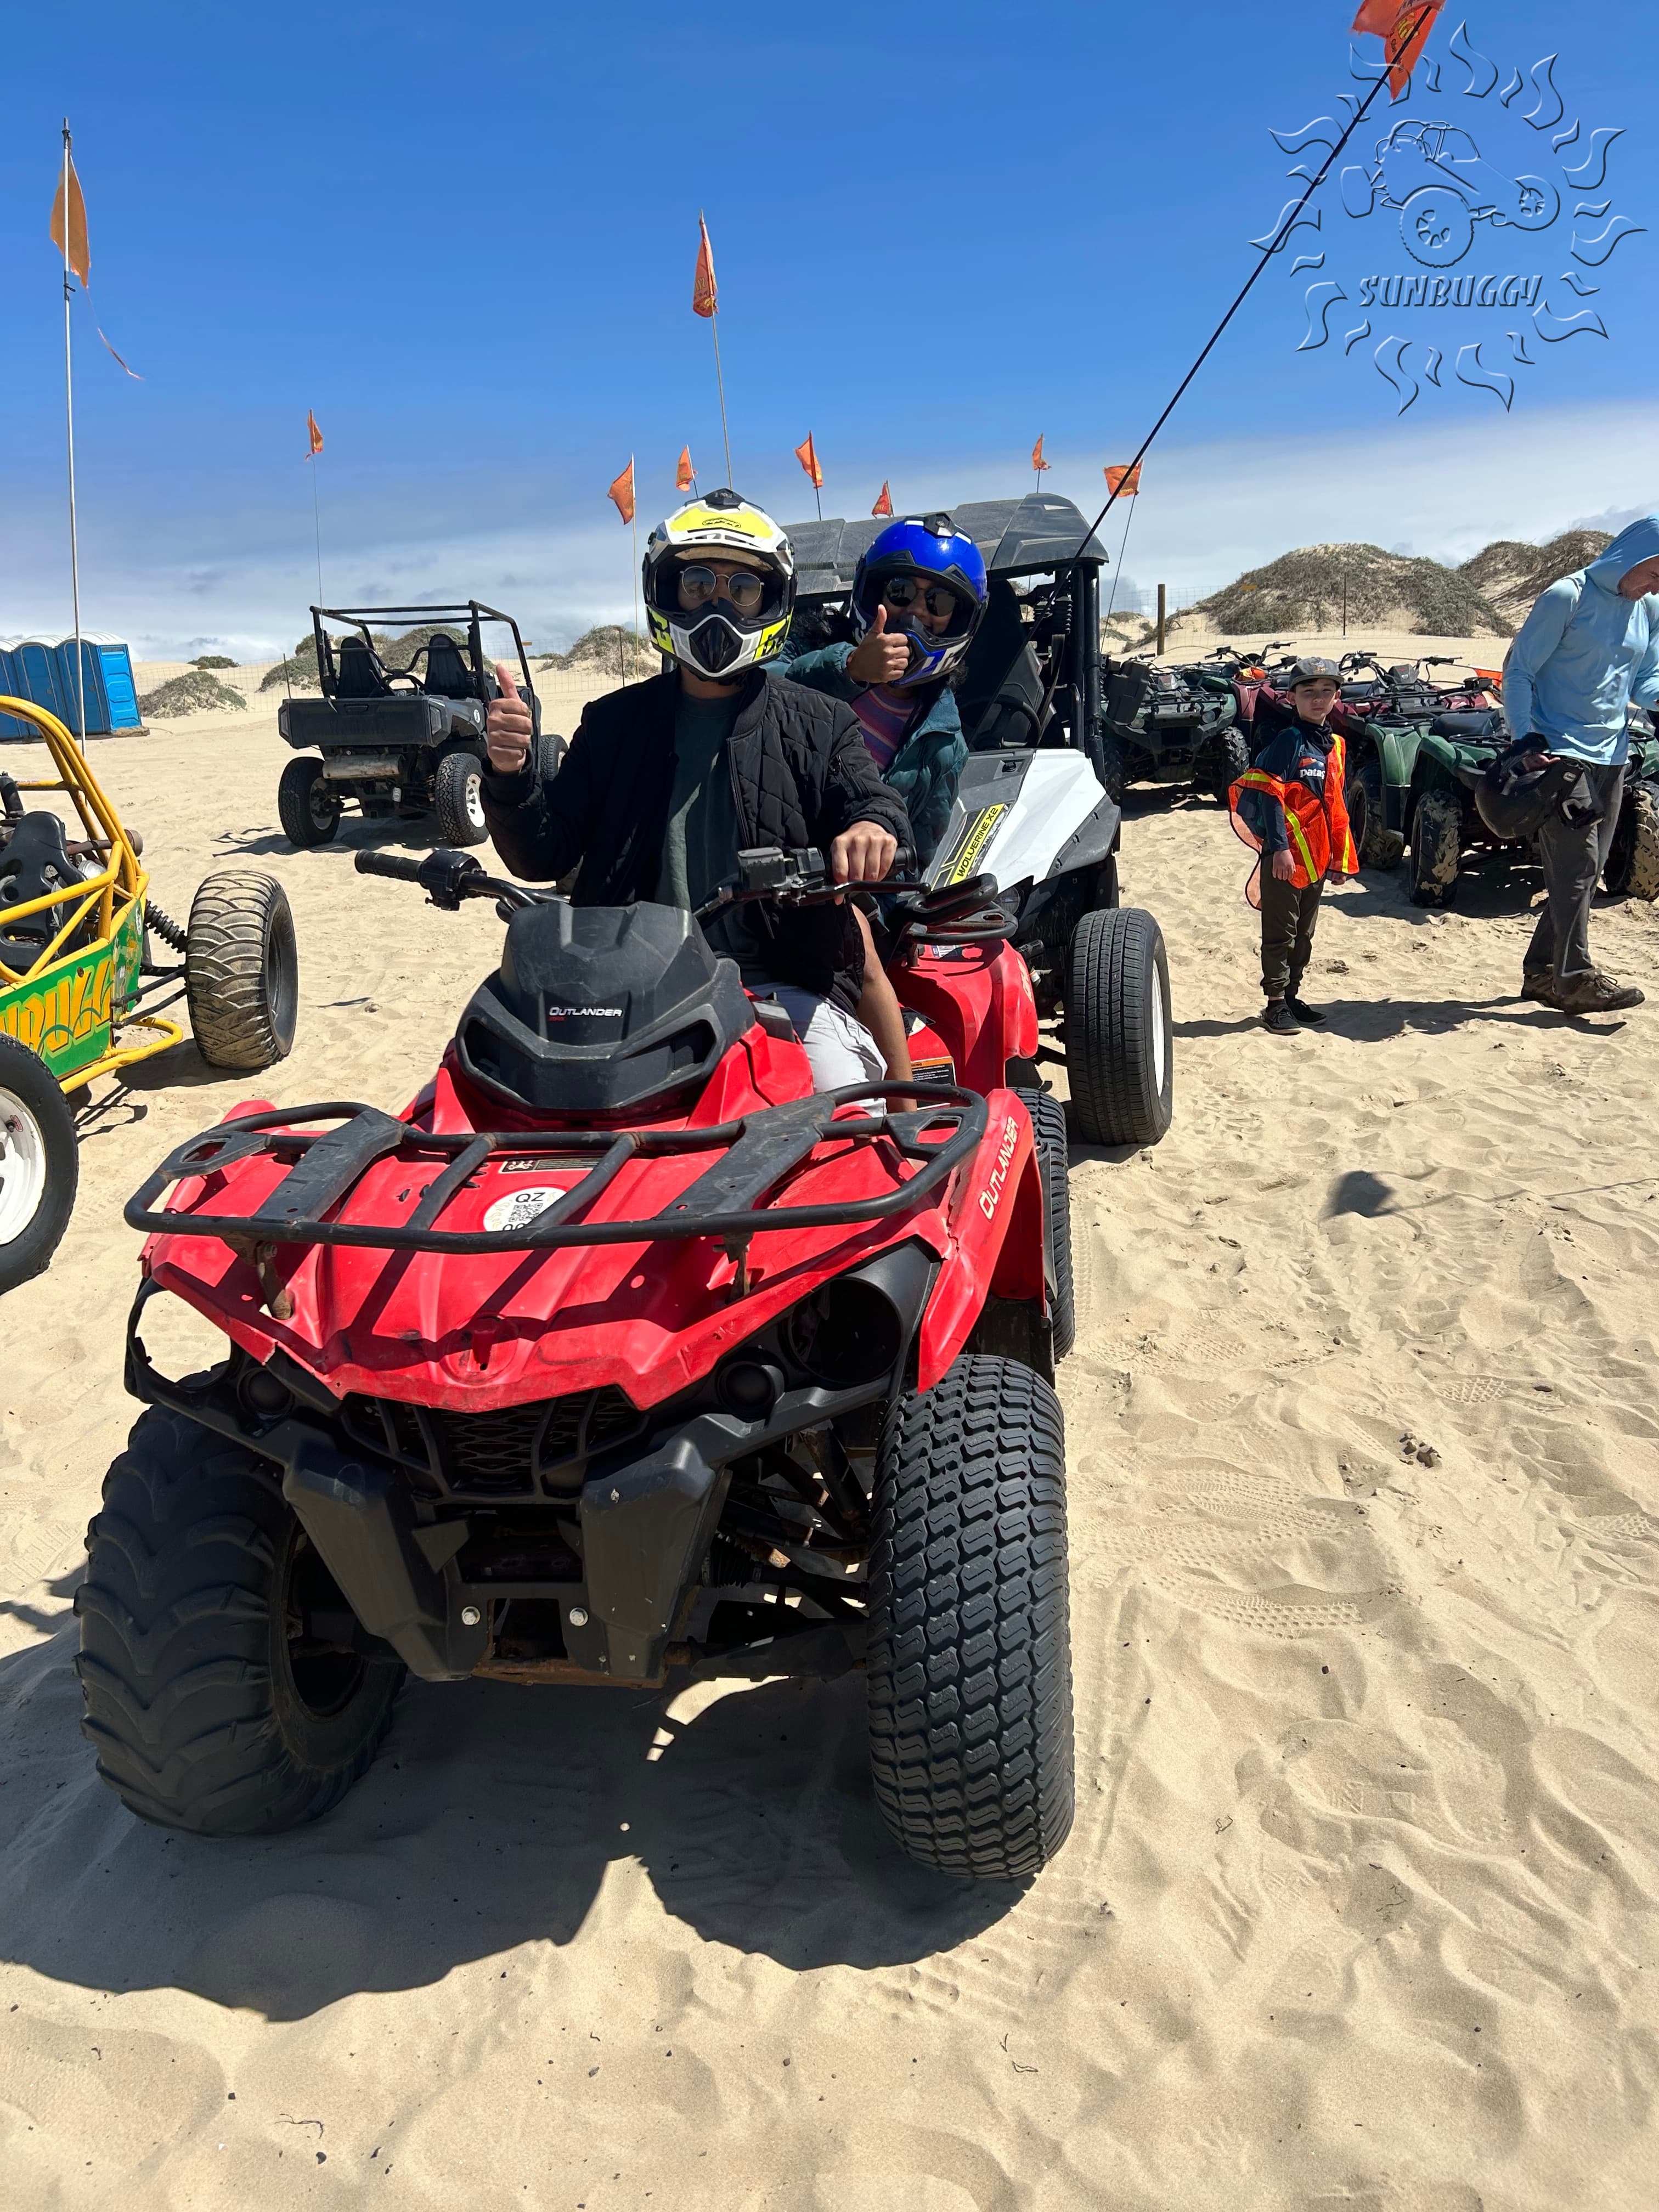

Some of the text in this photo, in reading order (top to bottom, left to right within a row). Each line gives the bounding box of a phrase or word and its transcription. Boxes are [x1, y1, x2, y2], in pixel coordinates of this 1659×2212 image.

[957, 808, 998, 877] WOLVERINE X2
[549, 1007, 623, 1017] OUTLANDER
[979, 1115, 1019, 1220] OUTLANDER
[516, 1192, 545, 1203] QZ
